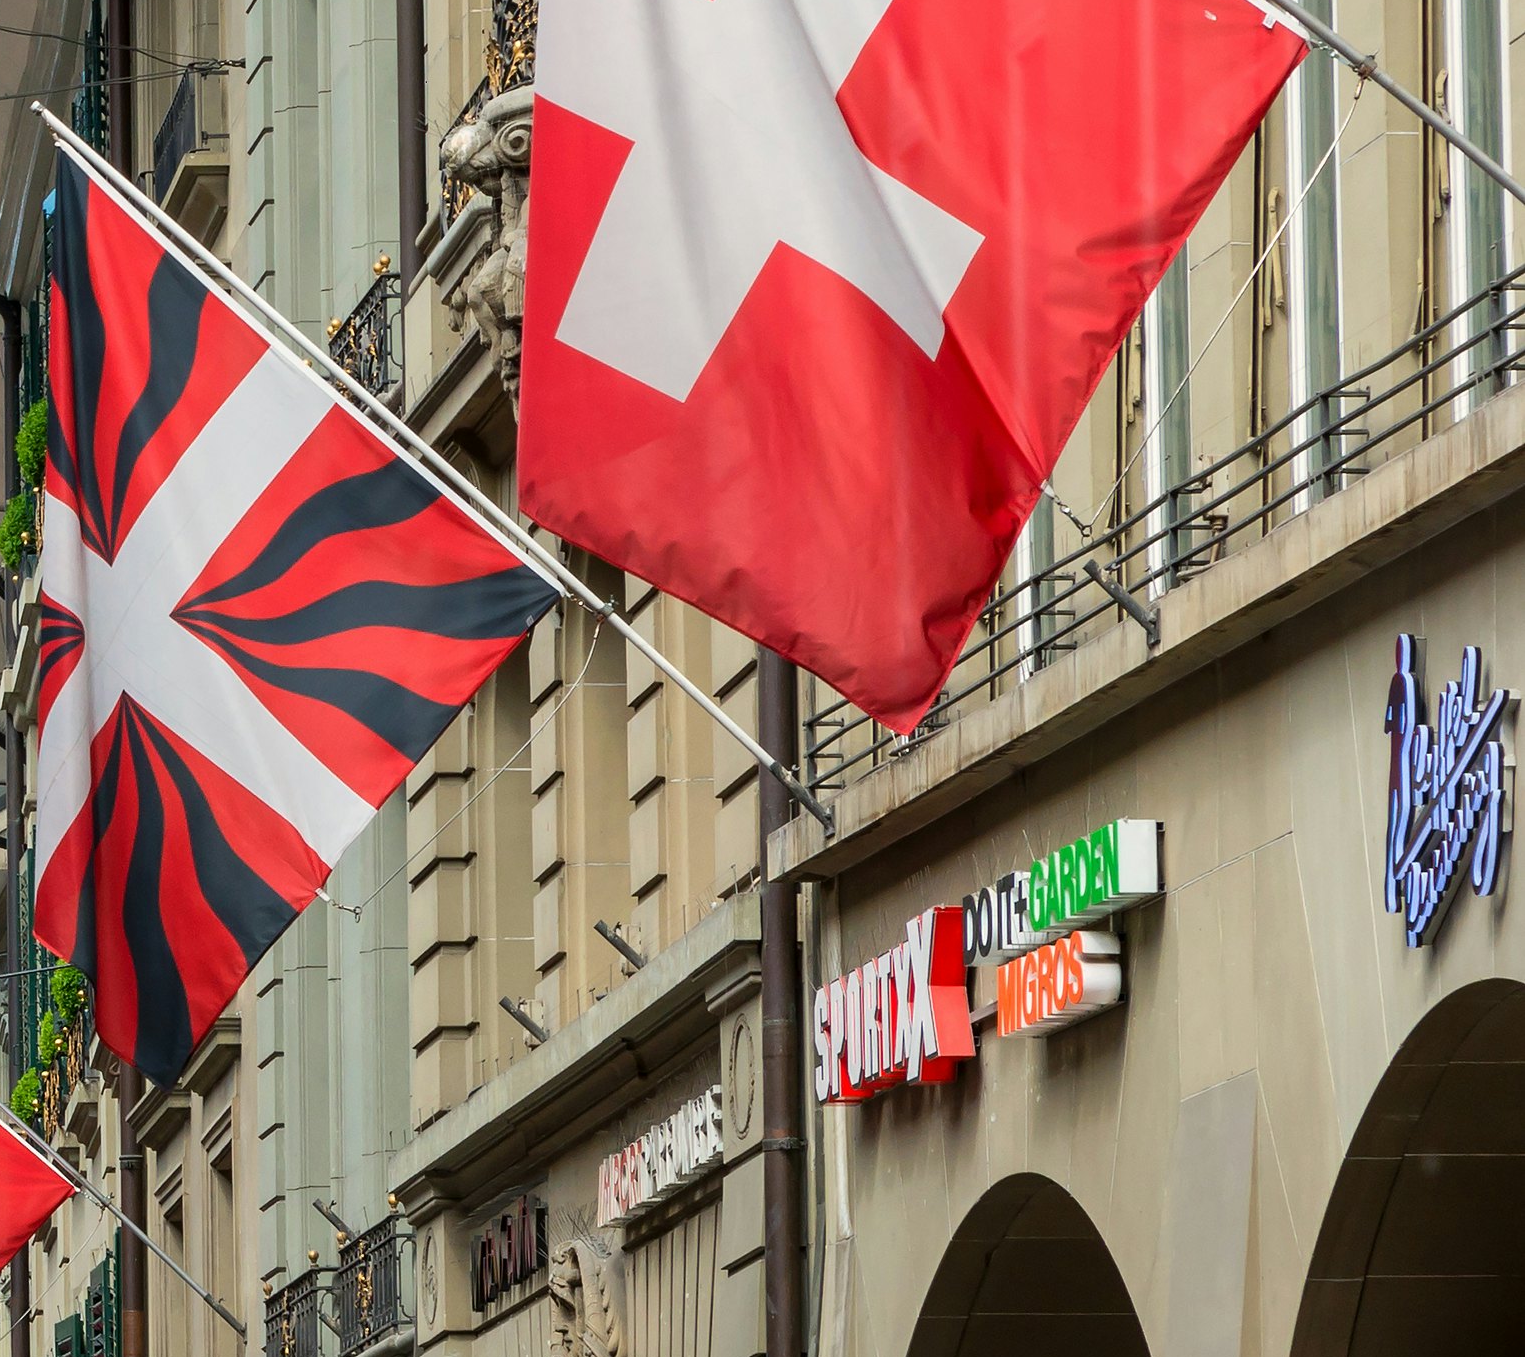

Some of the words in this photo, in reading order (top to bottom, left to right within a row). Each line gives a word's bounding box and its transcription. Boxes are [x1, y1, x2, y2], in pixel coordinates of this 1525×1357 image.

[1029, 819, 1119, 931] GARDEN
[814, 910, 938, 1102] SPORTXX
[997, 931, 1084, 1037] MIGROS
